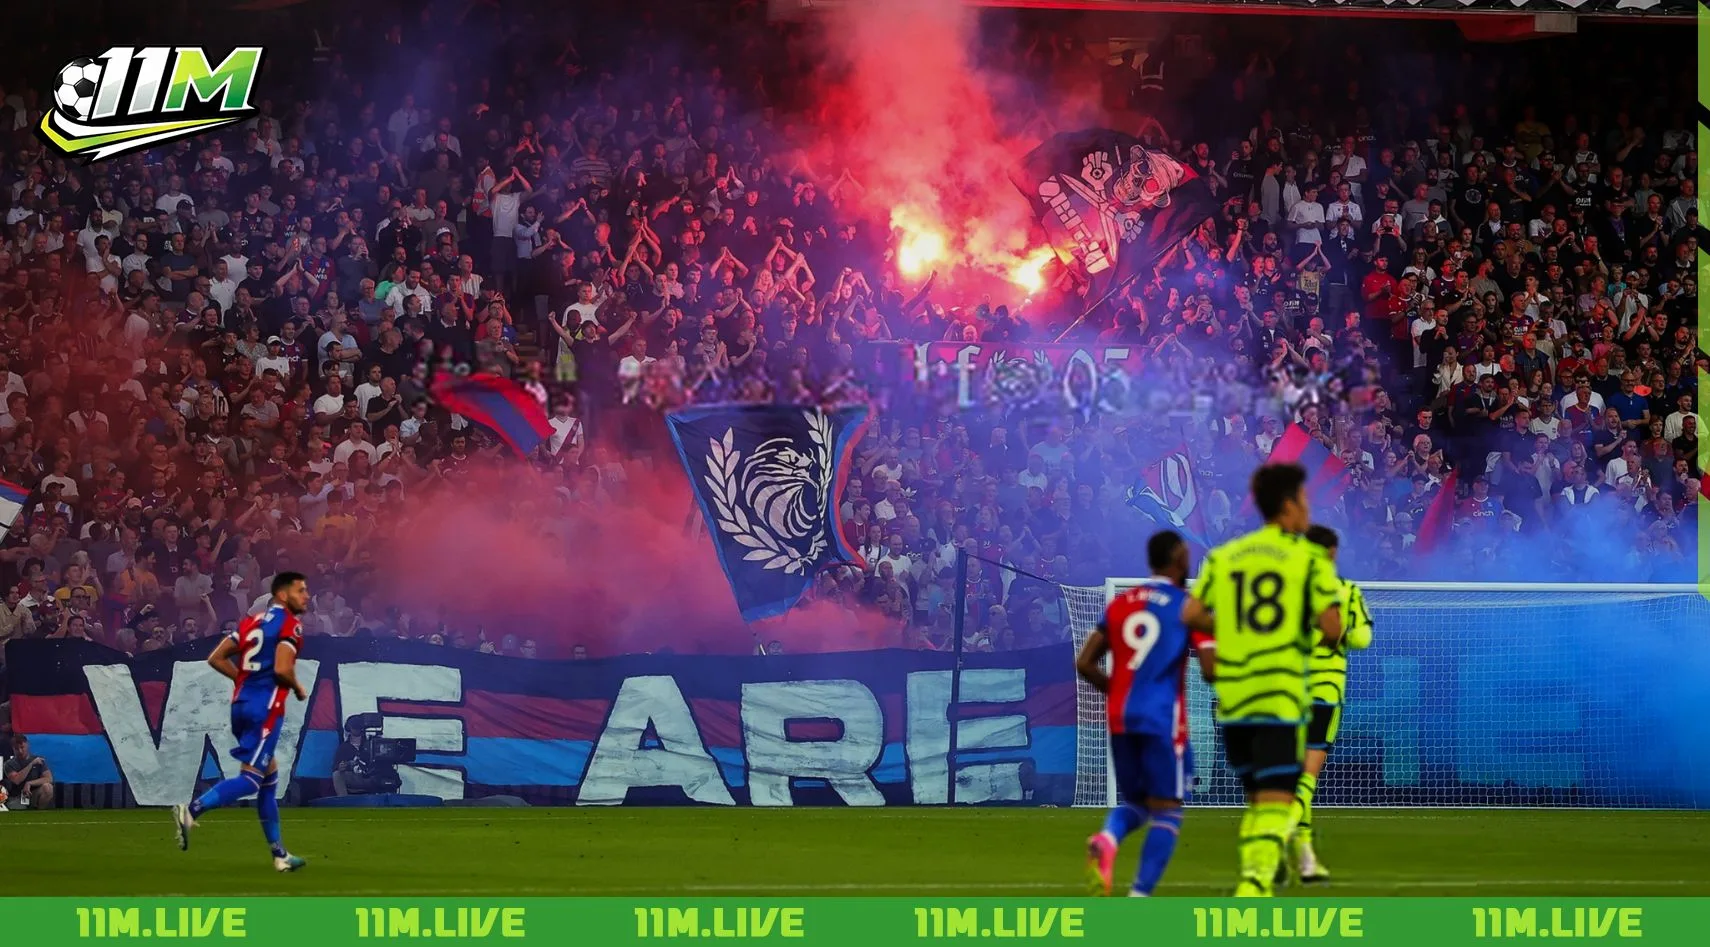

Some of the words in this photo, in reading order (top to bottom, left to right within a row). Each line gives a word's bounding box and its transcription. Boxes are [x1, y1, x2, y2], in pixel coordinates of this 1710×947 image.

[1472, 509, 1495, 517] cinch
[1230, 571, 1285, 633] 18
[242, 628, 264, 671] 2
[1123, 611, 1161, 670] 9
[83, 660, 465, 807] WE
[576, 668, 1029, 807] ARE
